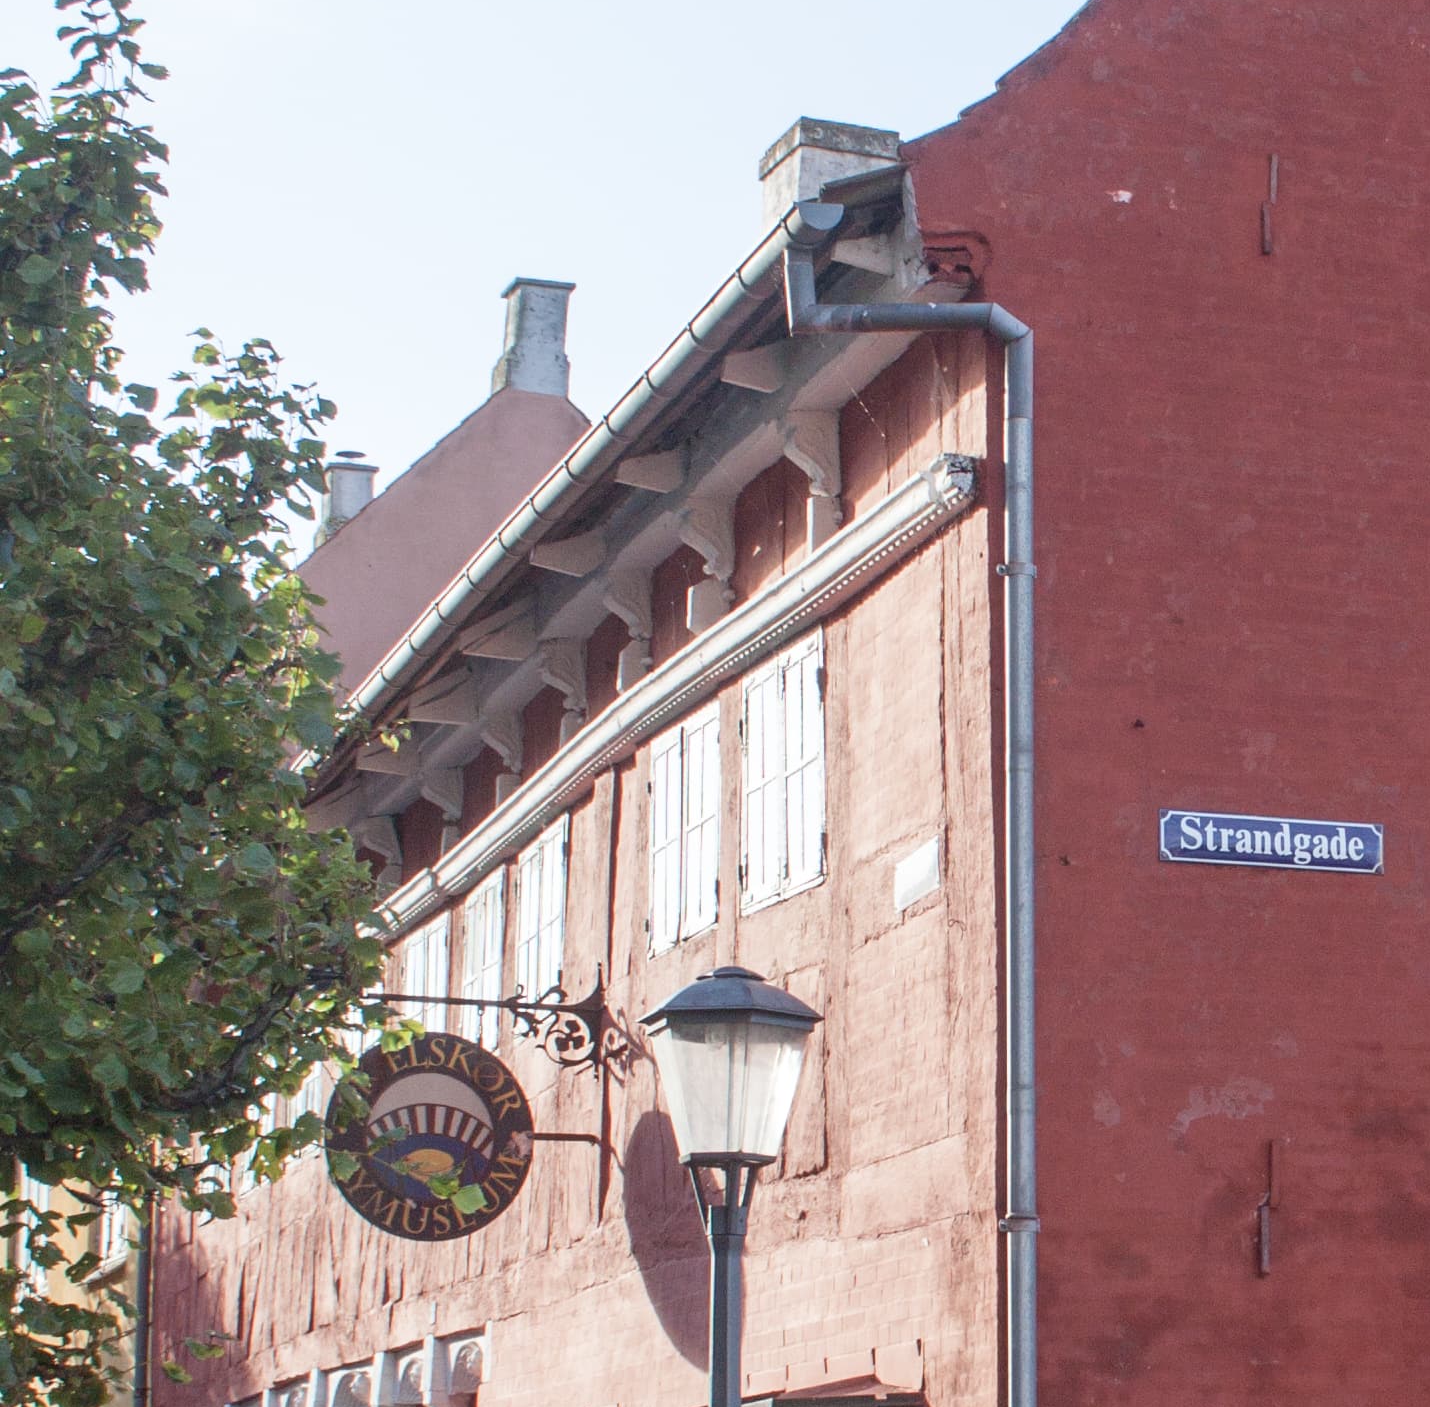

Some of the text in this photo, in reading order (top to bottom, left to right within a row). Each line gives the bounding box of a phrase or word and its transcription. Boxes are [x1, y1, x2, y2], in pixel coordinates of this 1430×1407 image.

[1180, 816, 1364, 865] Strandgade
[355, 1038, 521, 1120] ELSKØR
[347, 1153, 527, 1238] YMUSUM
